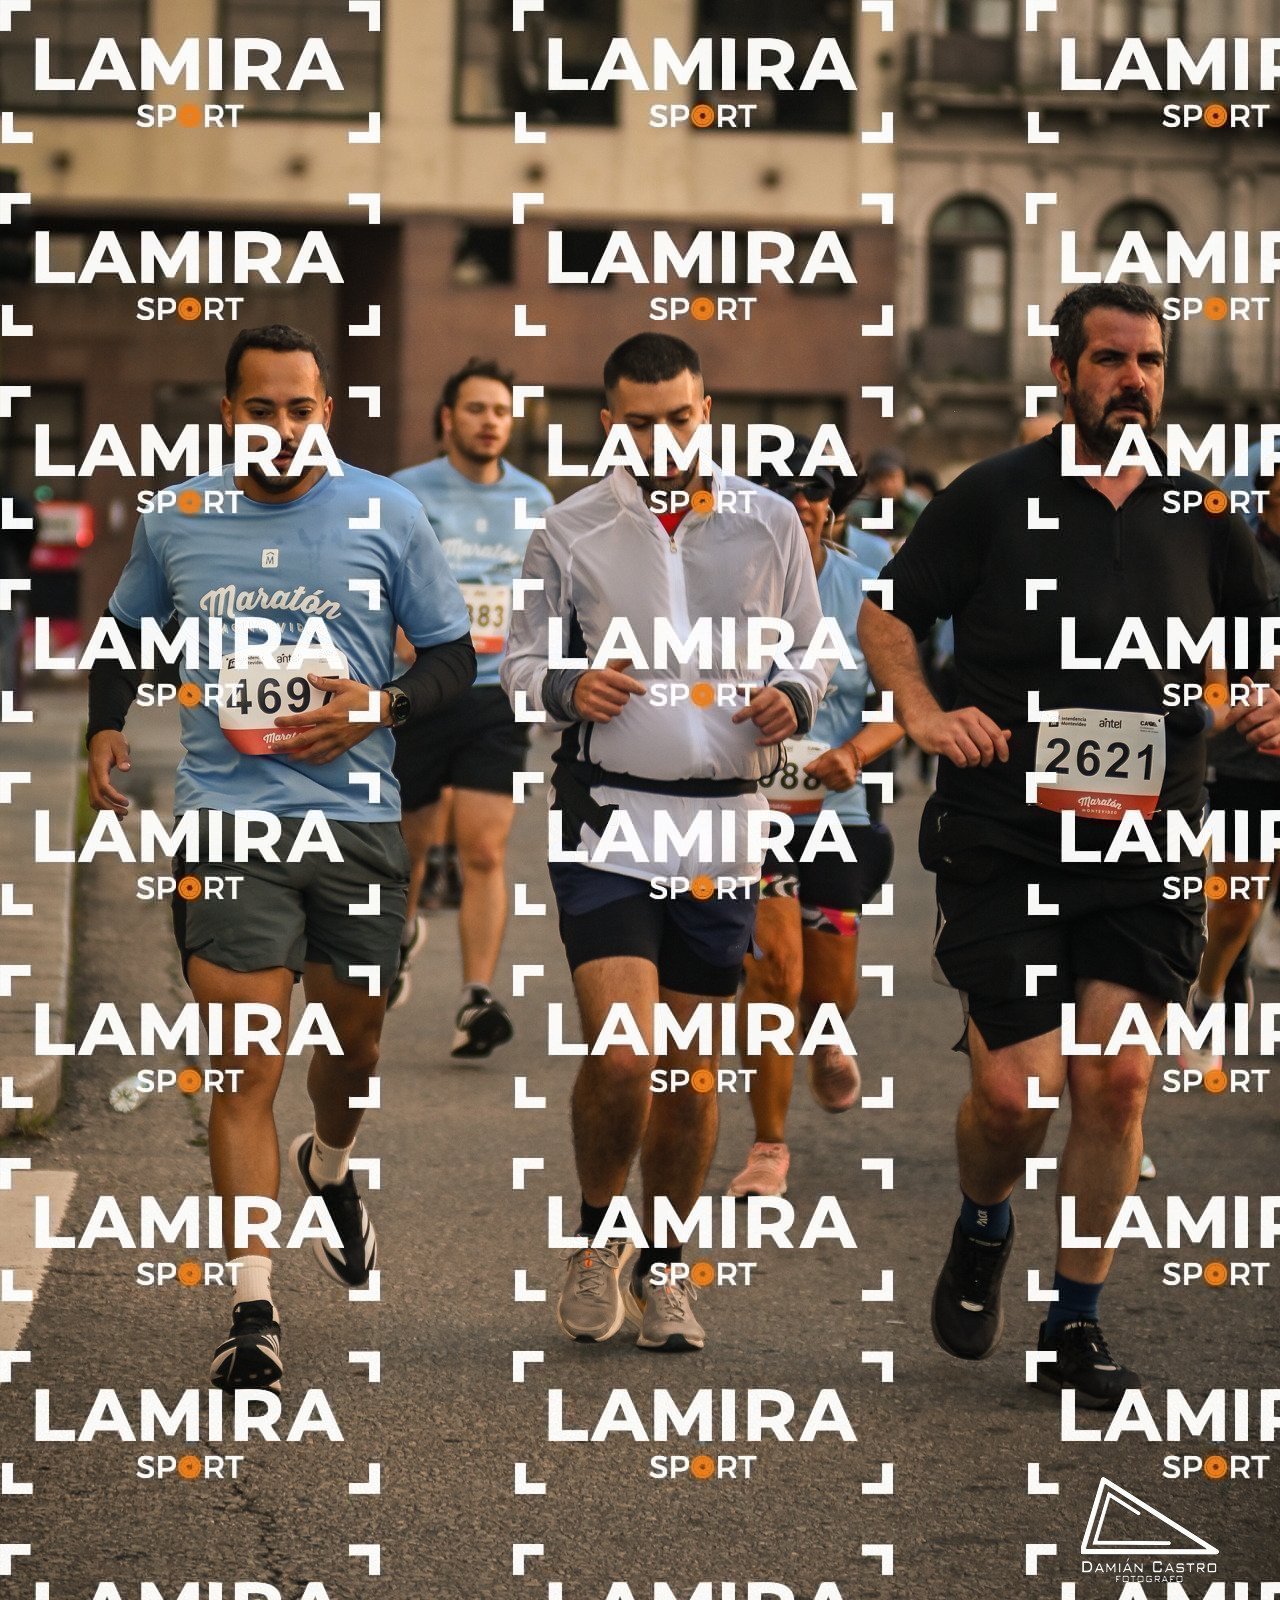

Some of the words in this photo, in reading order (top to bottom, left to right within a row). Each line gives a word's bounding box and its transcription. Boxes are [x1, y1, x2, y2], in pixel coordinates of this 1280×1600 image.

[200, 584, 342, 620] Maratón
[1098, 717, 1122, 729] antel
[263, 732, 297, 743] Mara
[1045, 737, 1154, 781] 2621
[1078, 796, 1122, 810] Maratón
